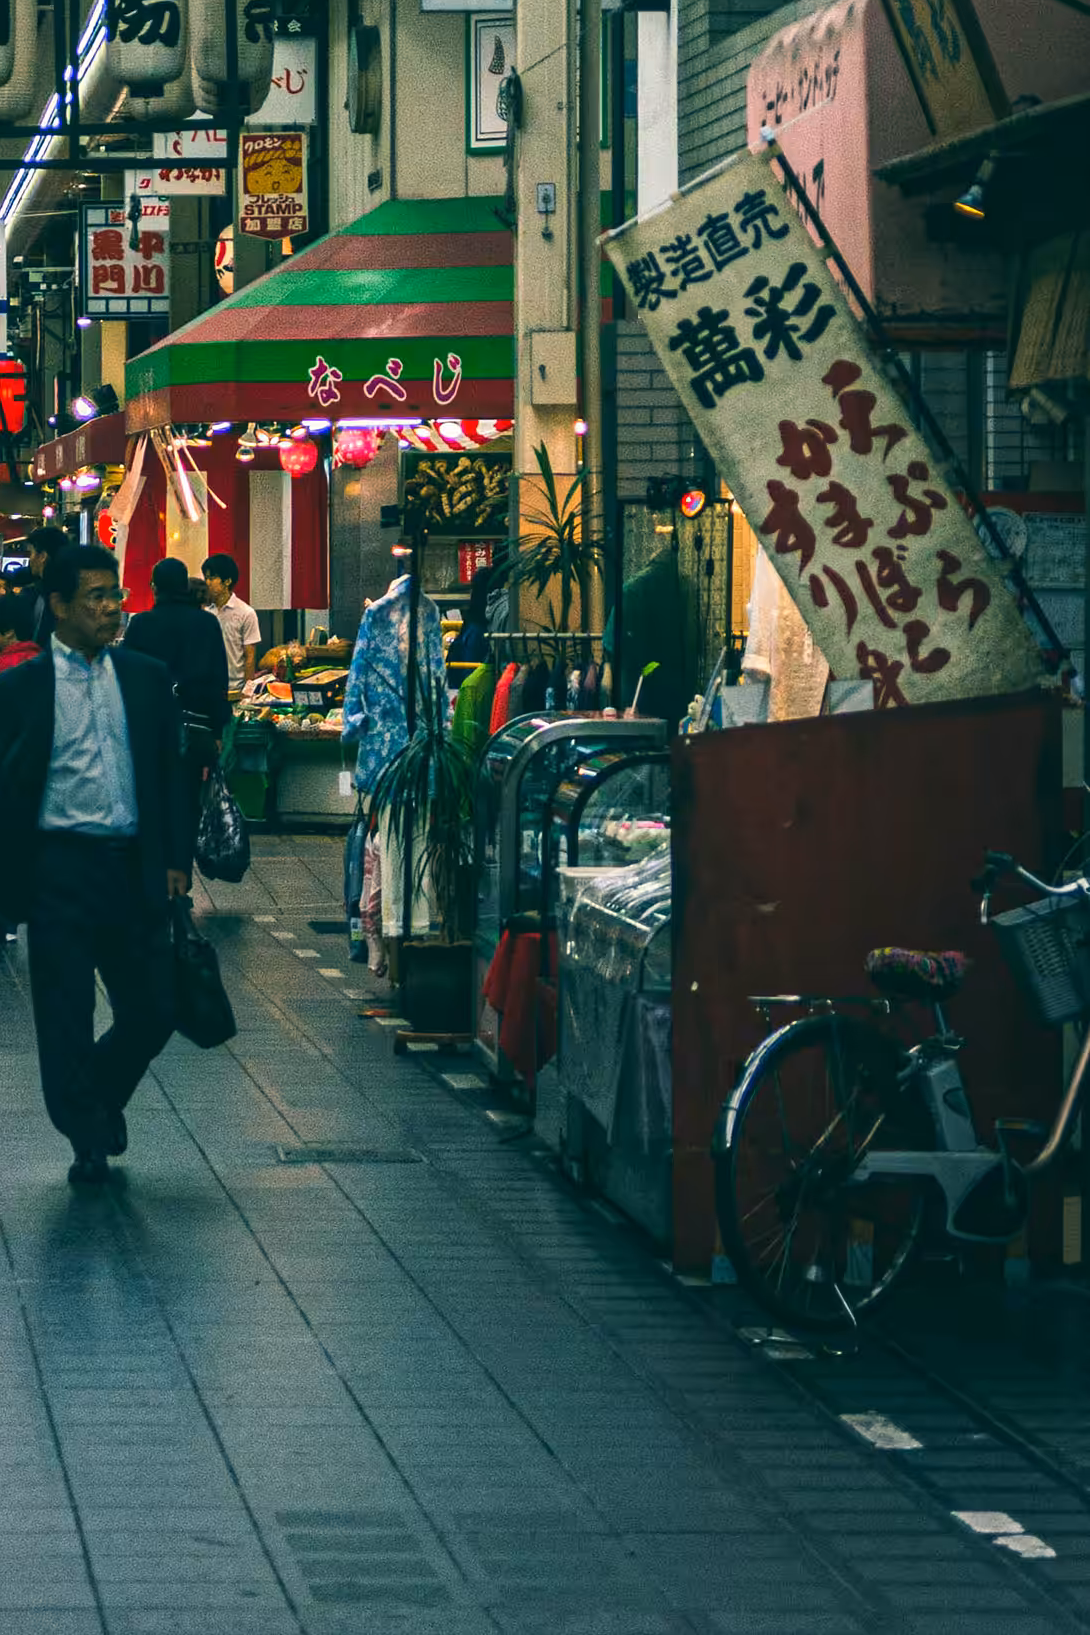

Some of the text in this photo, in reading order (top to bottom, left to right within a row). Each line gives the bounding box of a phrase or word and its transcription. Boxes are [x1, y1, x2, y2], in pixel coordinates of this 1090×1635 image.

[244, 137, 282, 153] クロモン
[244, 202, 303, 216] STAMP
[244, 217, 303, 232] 加盟店
[626, 189, 790, 312] 製造直売
[669, 261, 836, 408] 萬彩
[308, 354, 463, 407] なべじ
[776, 418, 951, 674] かまぼこ
